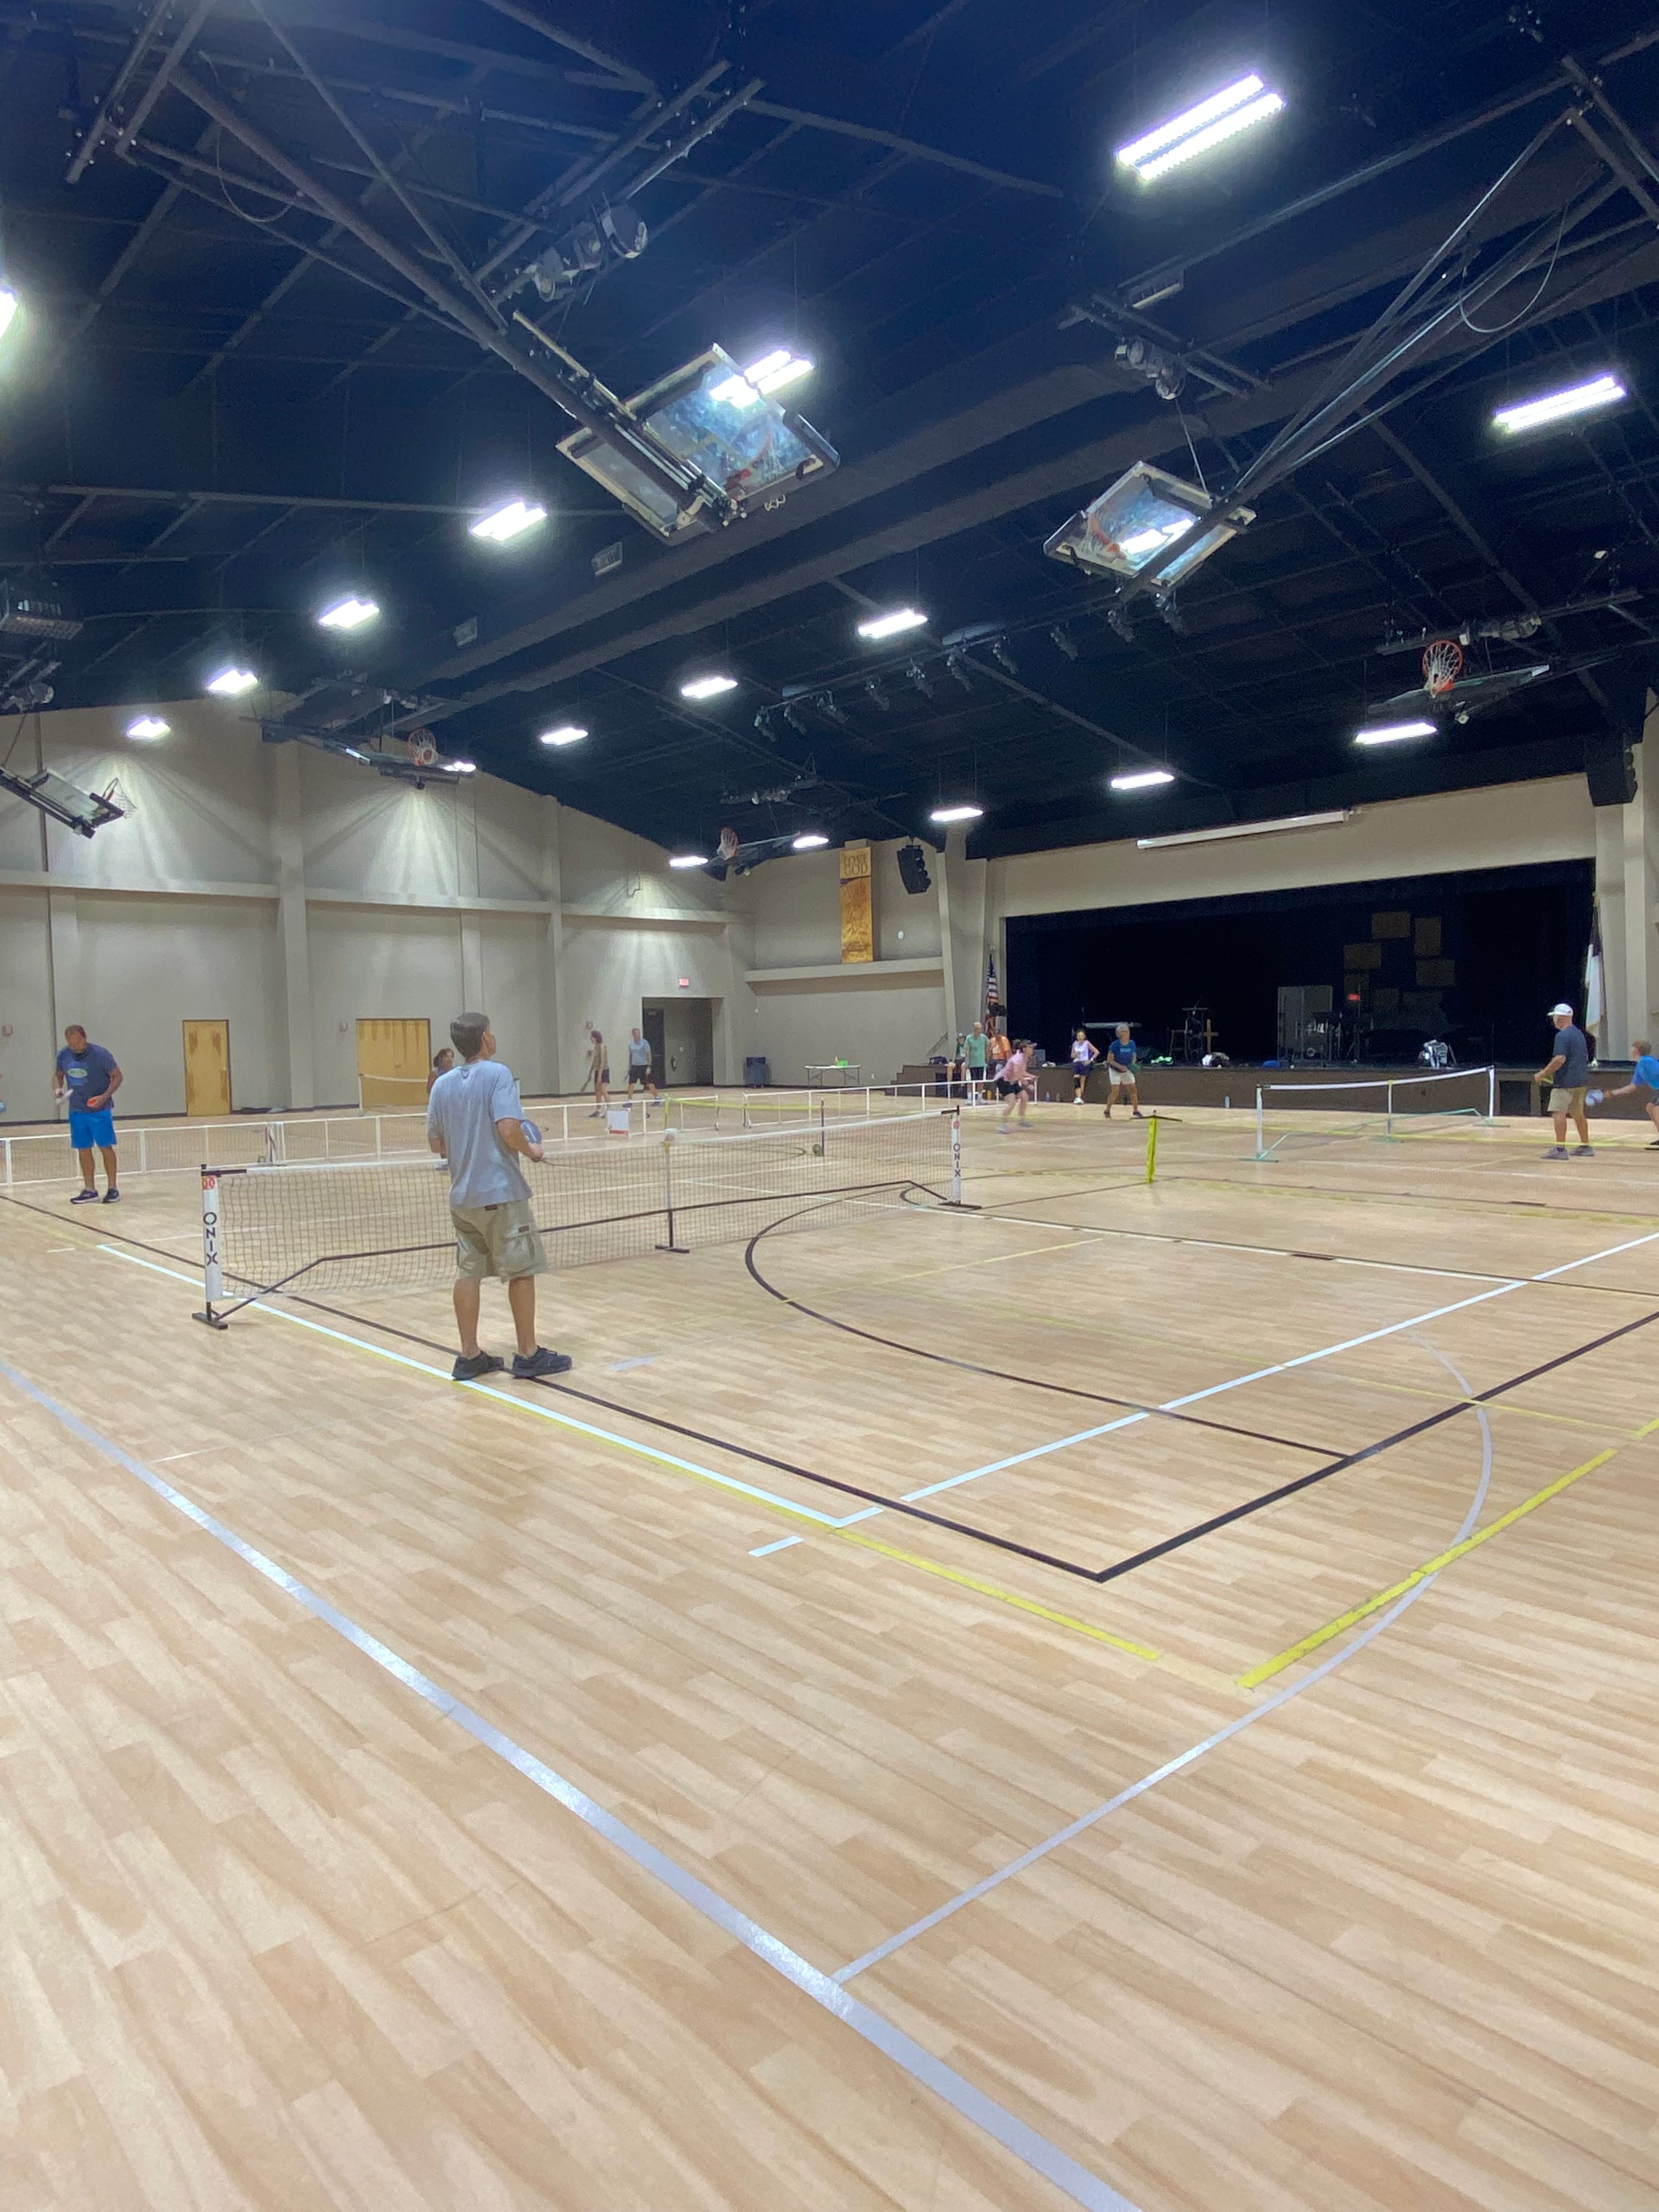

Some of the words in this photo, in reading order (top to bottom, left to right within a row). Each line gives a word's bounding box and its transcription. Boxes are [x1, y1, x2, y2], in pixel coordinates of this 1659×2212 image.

[843, 853, 868, 866] LOVE
[844, 864, 868, 876] GOD
[203, 1212, 218, 1266] ONIX
